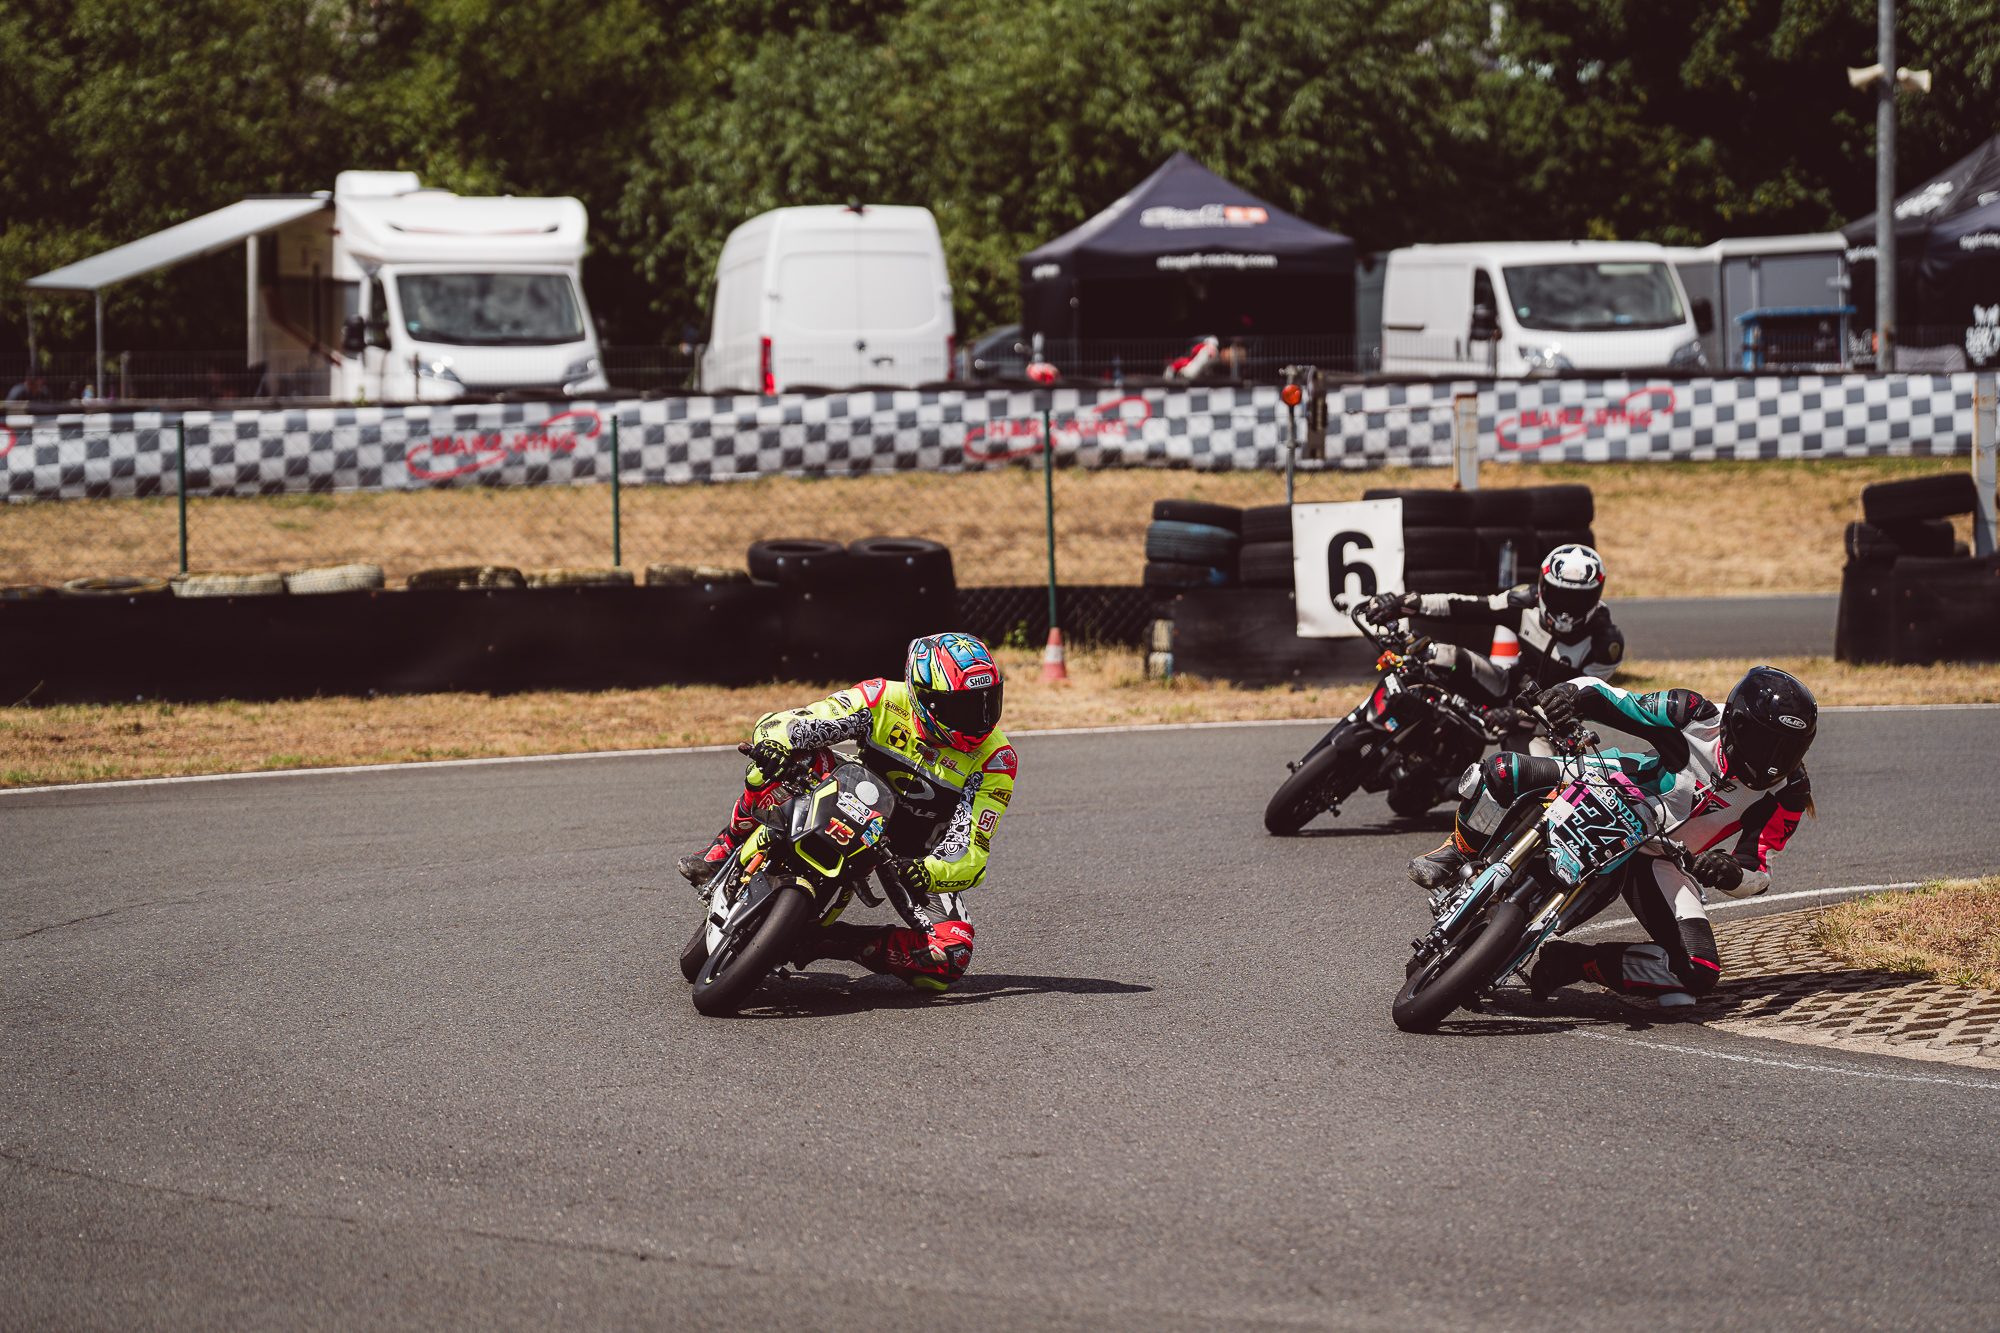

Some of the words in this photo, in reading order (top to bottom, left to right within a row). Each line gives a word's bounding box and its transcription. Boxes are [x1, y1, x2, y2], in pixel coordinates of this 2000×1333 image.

[1327, 531, 1378, 616] 6
[1606, 788, 1614, 797] 6
[1607, 798, 1616, 807] 9
[863, 808, 871, 817] 9
[1612, 794, 1643, 832] NDA
[858, 816, 865, 824] 6
[935, 879, 971, 888] RECORD
